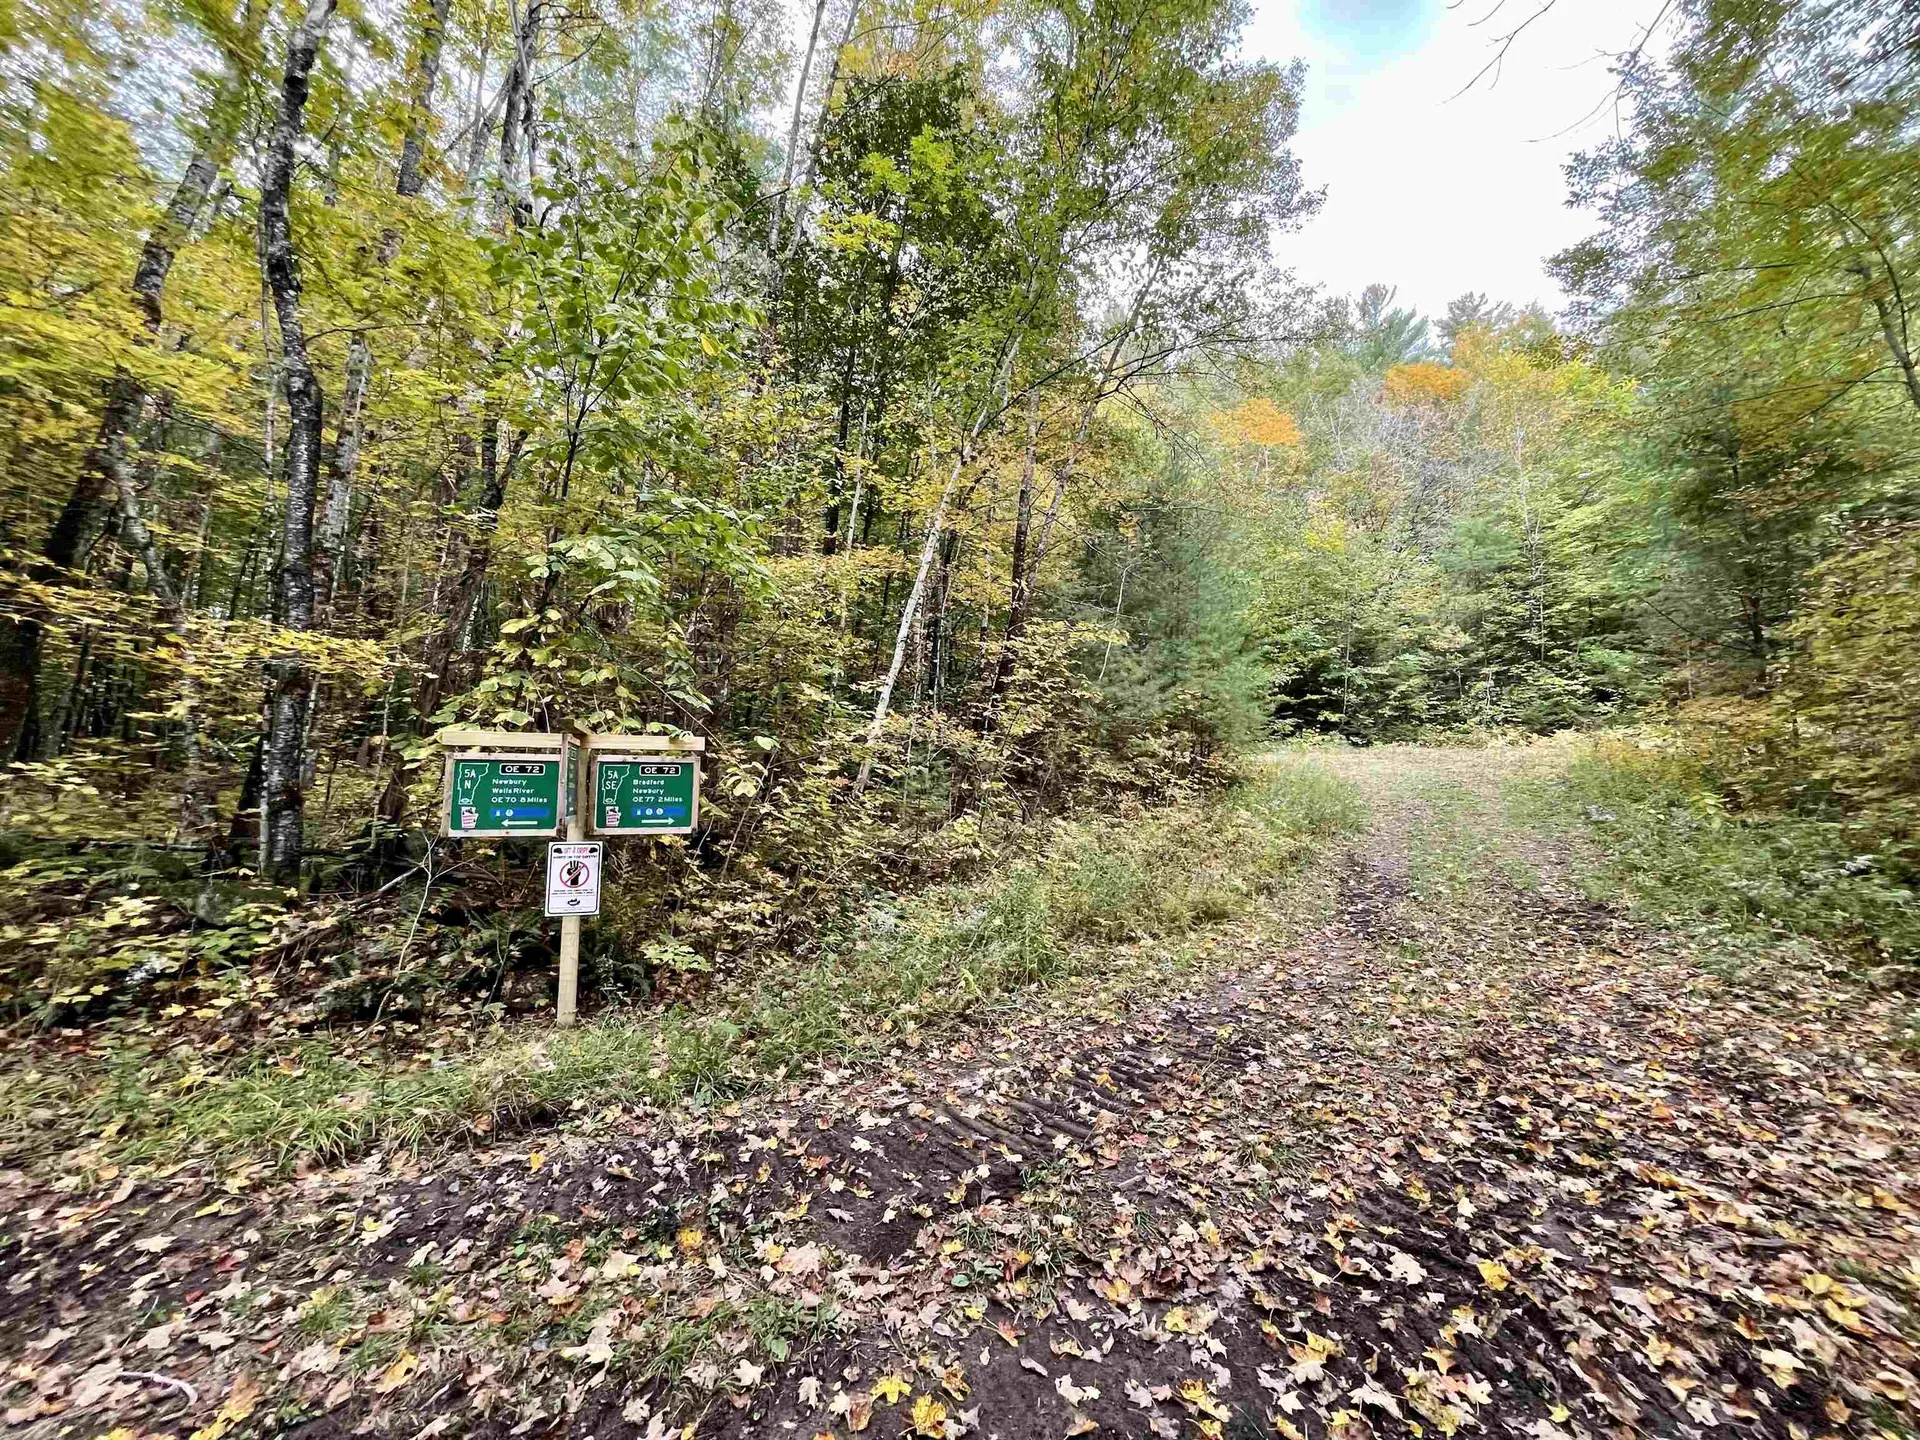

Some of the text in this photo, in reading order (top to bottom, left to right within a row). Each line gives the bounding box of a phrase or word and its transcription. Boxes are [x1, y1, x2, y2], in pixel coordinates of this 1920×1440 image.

[464, 769, 476, 778] 5A
[607, 771, 618, 779] 5A
[464, 781, 471, 789] N
[605, 781, 617, 790] SE
